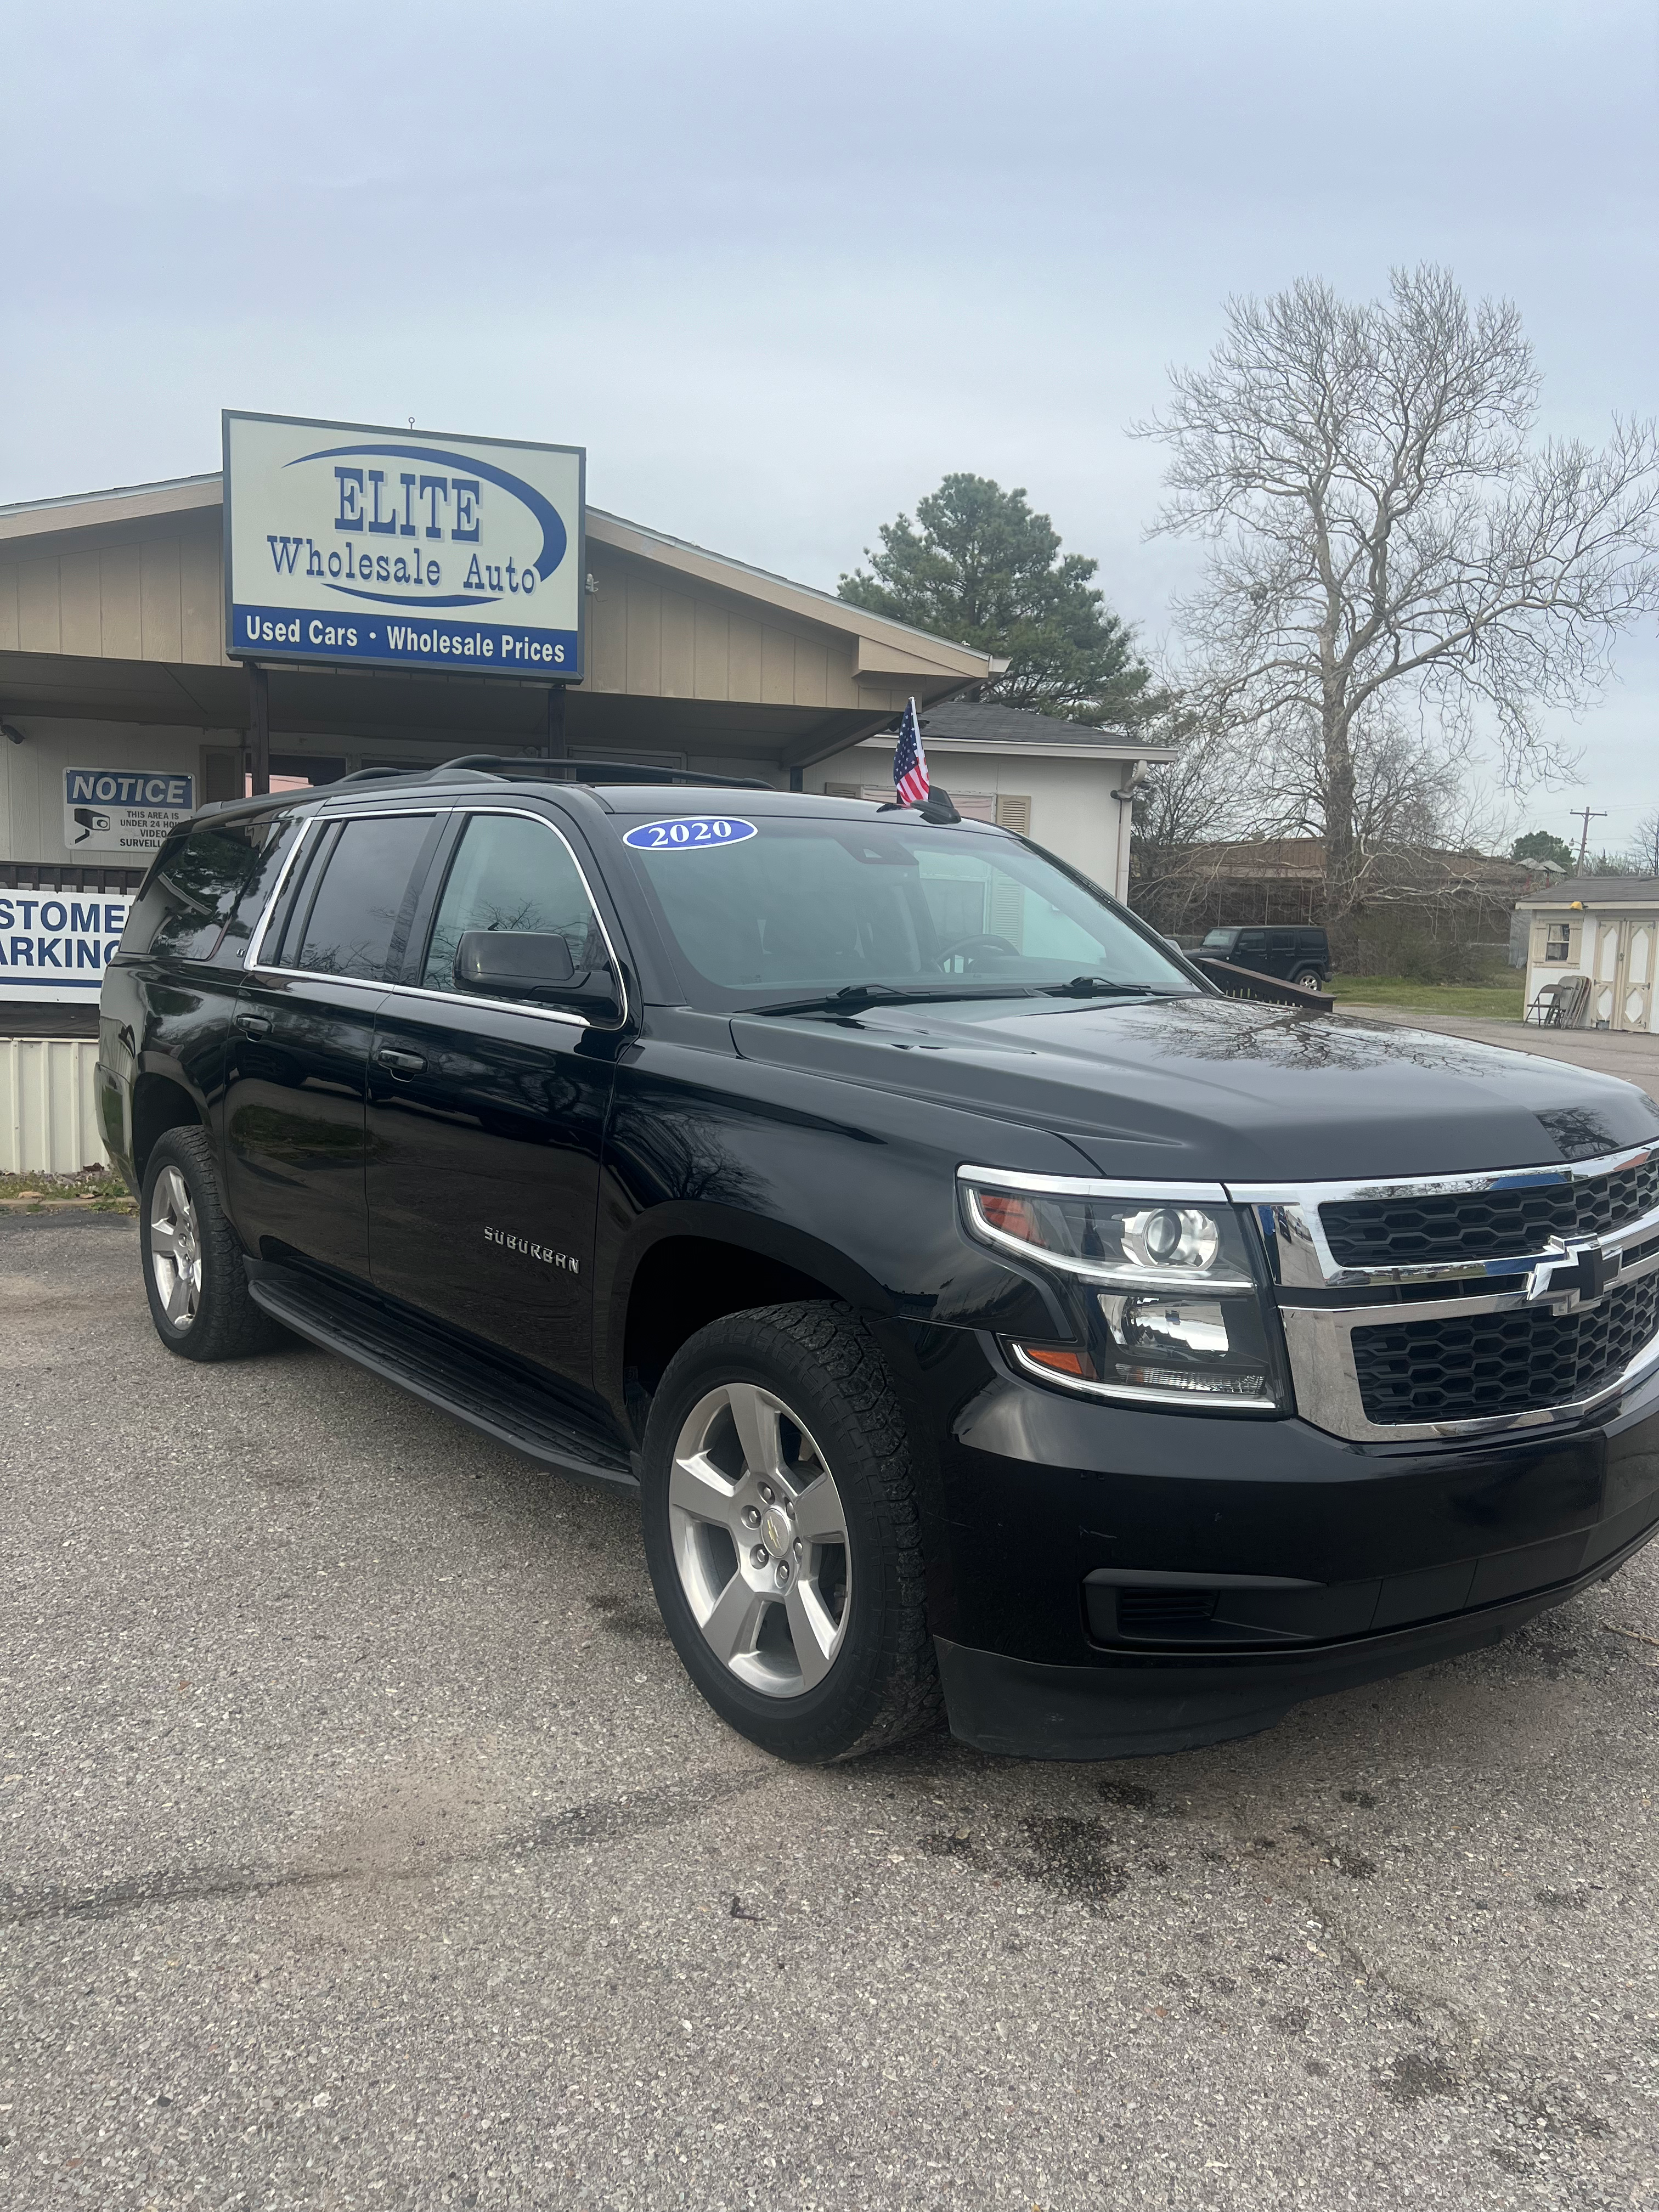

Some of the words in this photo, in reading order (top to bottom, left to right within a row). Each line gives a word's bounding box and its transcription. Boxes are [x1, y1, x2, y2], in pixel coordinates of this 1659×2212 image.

[334, 466, 481, 544] ELITE
[267, 535, 441, 586] Wholesale
[463, 553, 535, 595] Auto
[246, 615, 300, 642] Used
[308, 619, 358, 646] Cars
[387, 625, 494, 657] Wholesale
[501, 635, 565, 662] Prices
[72, 776, 187, 804] NOTICE
[120, 819, 148, 827] UNDER
[127, 810, 145, 819] THIS
[140, 829, 167, 838] VIDEO
[648, 820, 732, 847] 2020
[0, 899, 132, 933] STOME
[484, 1226, 579, 1274] SUBURBAN
